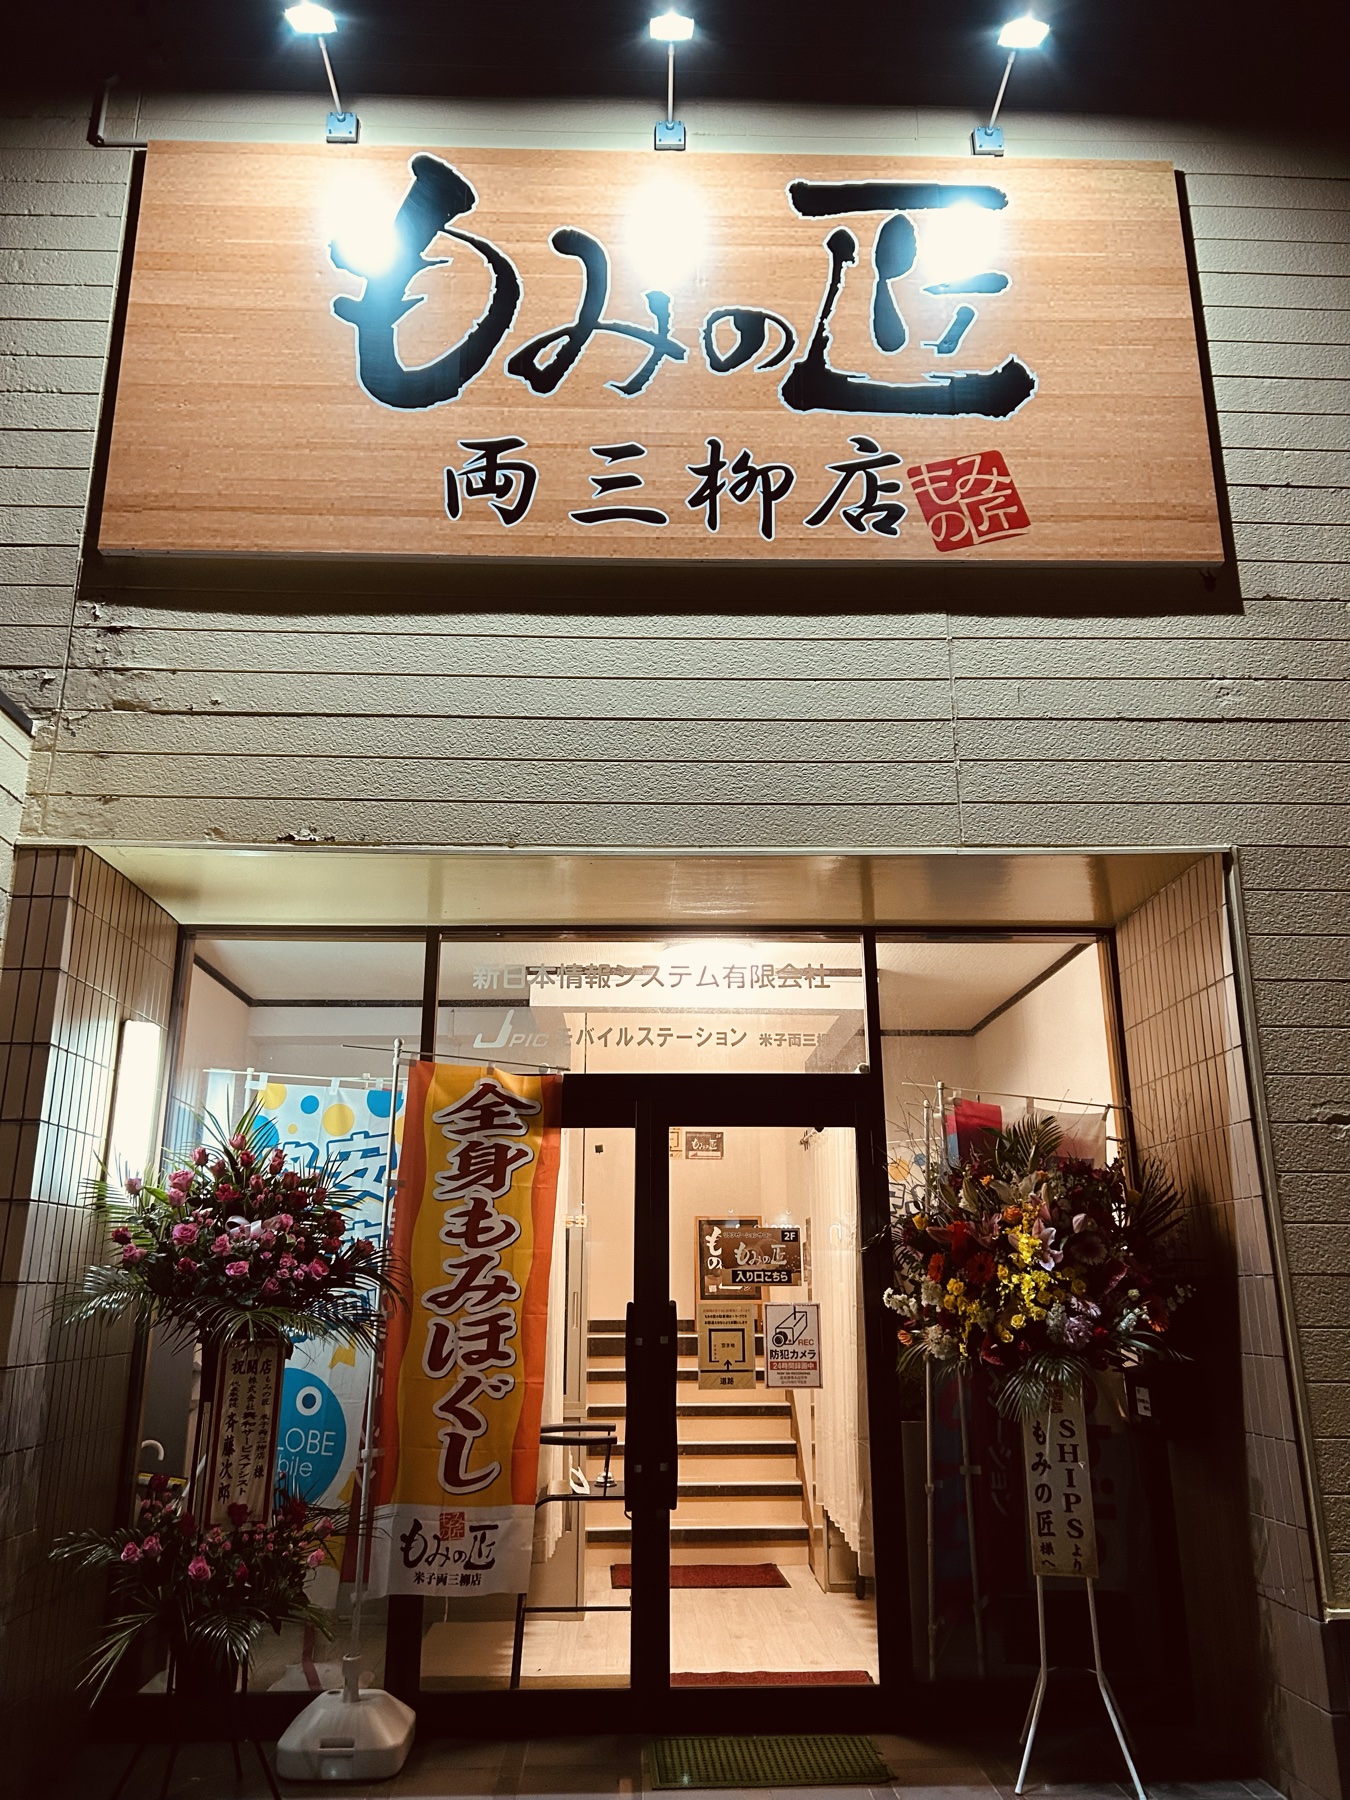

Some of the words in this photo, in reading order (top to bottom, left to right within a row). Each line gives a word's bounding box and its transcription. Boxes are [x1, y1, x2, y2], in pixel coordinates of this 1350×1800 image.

[328, 153, 1039, 419] もみの匠
[443, 436, 909, 540] 両三柳店
[472, 962, 831, 990] 新日本情報システム有限会社
[784, 1232, 796, 1241] 2F
[733, 1241, 788, 1266] もみの匠
[735, 1271, 788, 1283] 入り口こちら
[423, 1080, 541, 1495] 全身もみほぐし
[797, 1338, 815, 1346] REC
[769, 1349, 817, 1360] 防犯カメラ
[772, 1361, 815, 1371] 24時間録画中
[719, 1377, 735, 1385] 道路
[399, 1517, 499, 1571] もみの匠
[413, 1571, 482, 1587] 米子両三柳店
